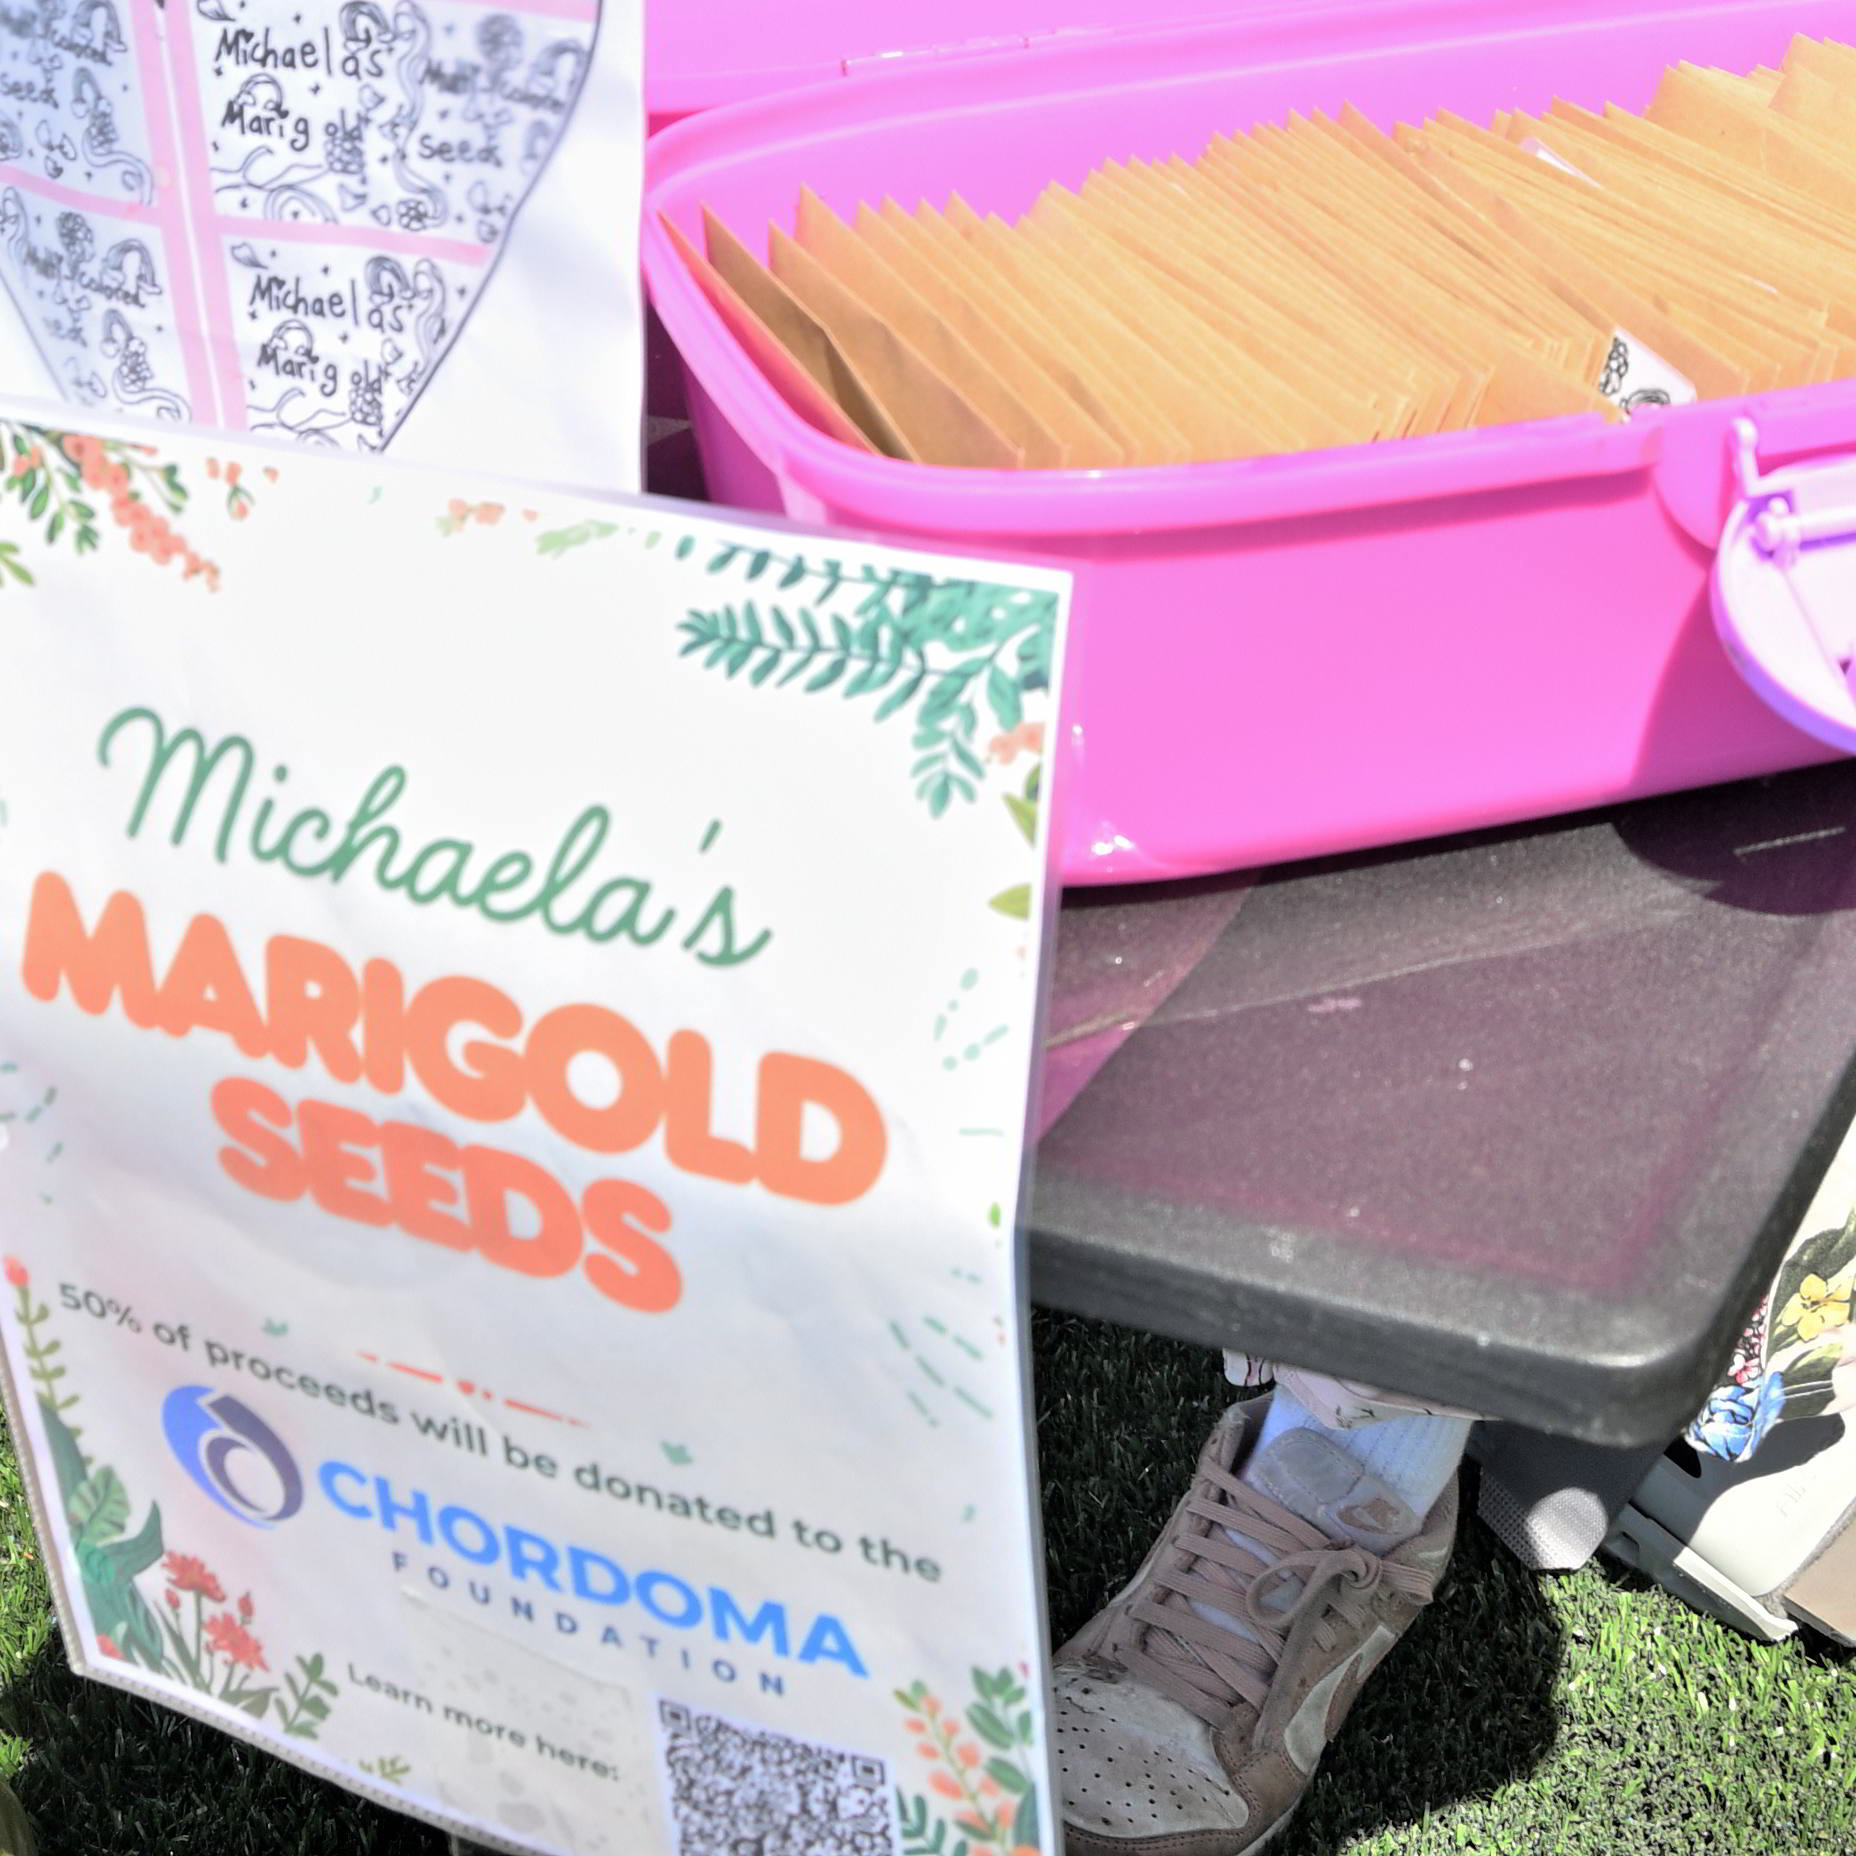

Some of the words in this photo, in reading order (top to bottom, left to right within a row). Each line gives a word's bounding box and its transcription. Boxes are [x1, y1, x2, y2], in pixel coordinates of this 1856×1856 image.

[96, 706, 774, 968] Michaela's
[21, 871, 889, 1207] MARIGOLD
[209, 1076, 685, 1314] SEEDS
[59, 1282, 143, 1334] 50%
[153, 1321, 191, 1352] of
[205, 1336, 400, 1425] proceeds
[410, 1408, 488, 1457] will
[503, 1435, 558, 1480] be
[574, 1462, 777, 1540] donated
[792, 1519, 845, 1555] to
[859, 1535, 943, 1584] the
[318, 1459, 871, 1680] CHORDOMA
[392, 1551, 787, 1697] FOUNDATION
[347, 1661, 434, 1715] Learn
[444, 1705, 526, 1749] more
[535, 1732, 620, 1782] here:
